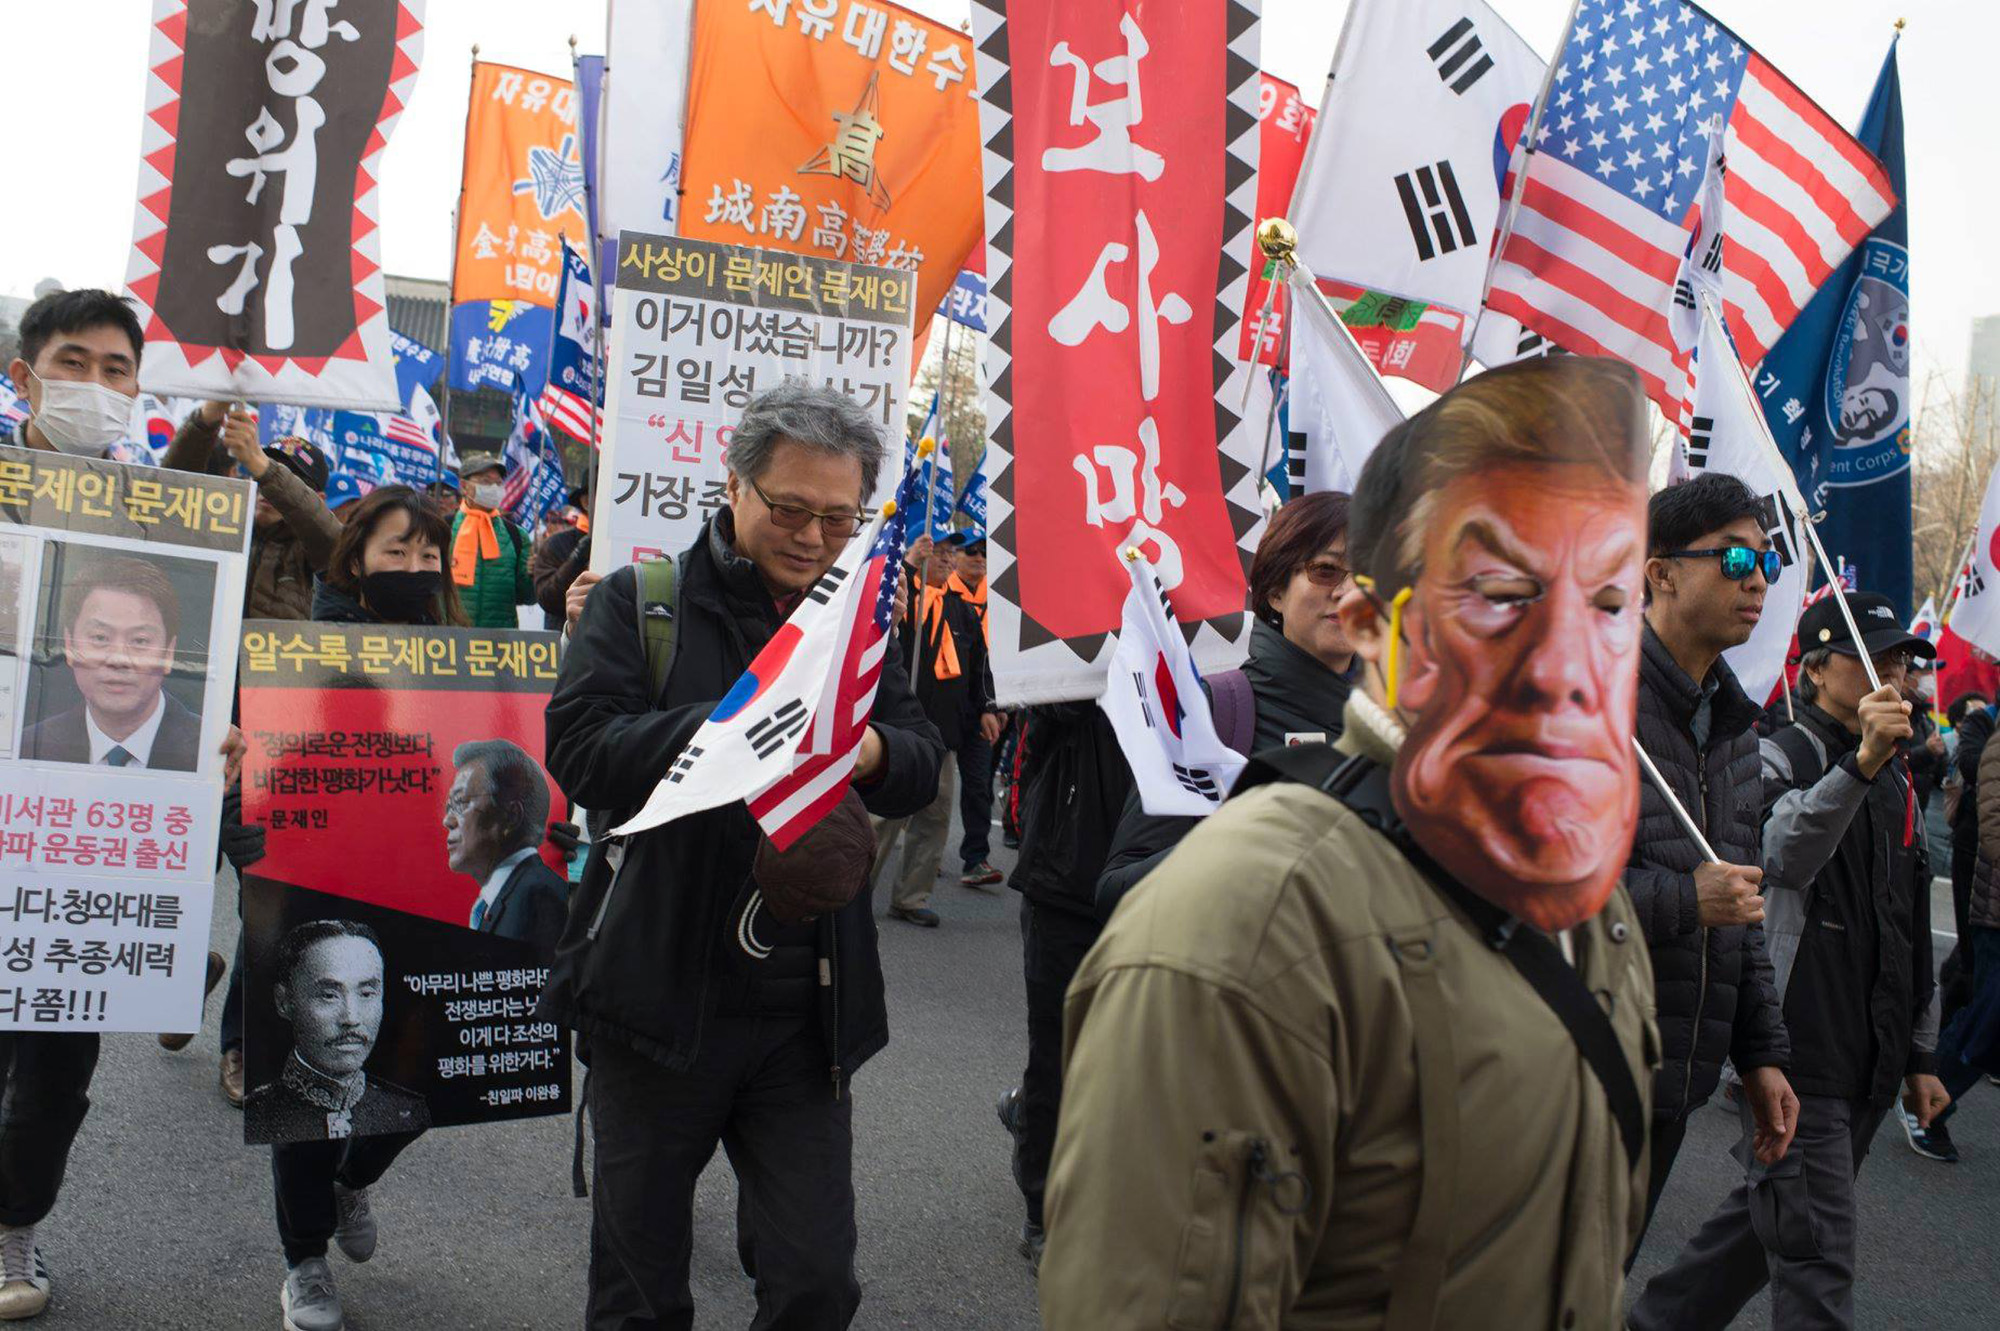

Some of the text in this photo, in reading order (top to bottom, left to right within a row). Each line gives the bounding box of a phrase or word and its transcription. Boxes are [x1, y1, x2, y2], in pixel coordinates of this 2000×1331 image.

[621, 243, 908, 314] 사상이 문제인 문재인
[1864, 249, 1908, 283] 극기
[630, 352, 756, 409] 김일성
[1829, 450, 1898, 474] ent Corps
[0, 460, 242, 535] 문제인 문재인
[613, 472, 695, 520] 가장
[244, 631, 557, 679] 알수록 문제인 문재인
[86, 801, 154, 834] 63명
[164, 806, 193, 836] 중
[41, 832, 128, 867] 운동권
[133, 838, 189, 871] 출신
[0, 936, 36, 973] 성
[459, 1021, 558, 1048] 이게 다 조선의
[437, 1054, 488, 1079] 평화를
